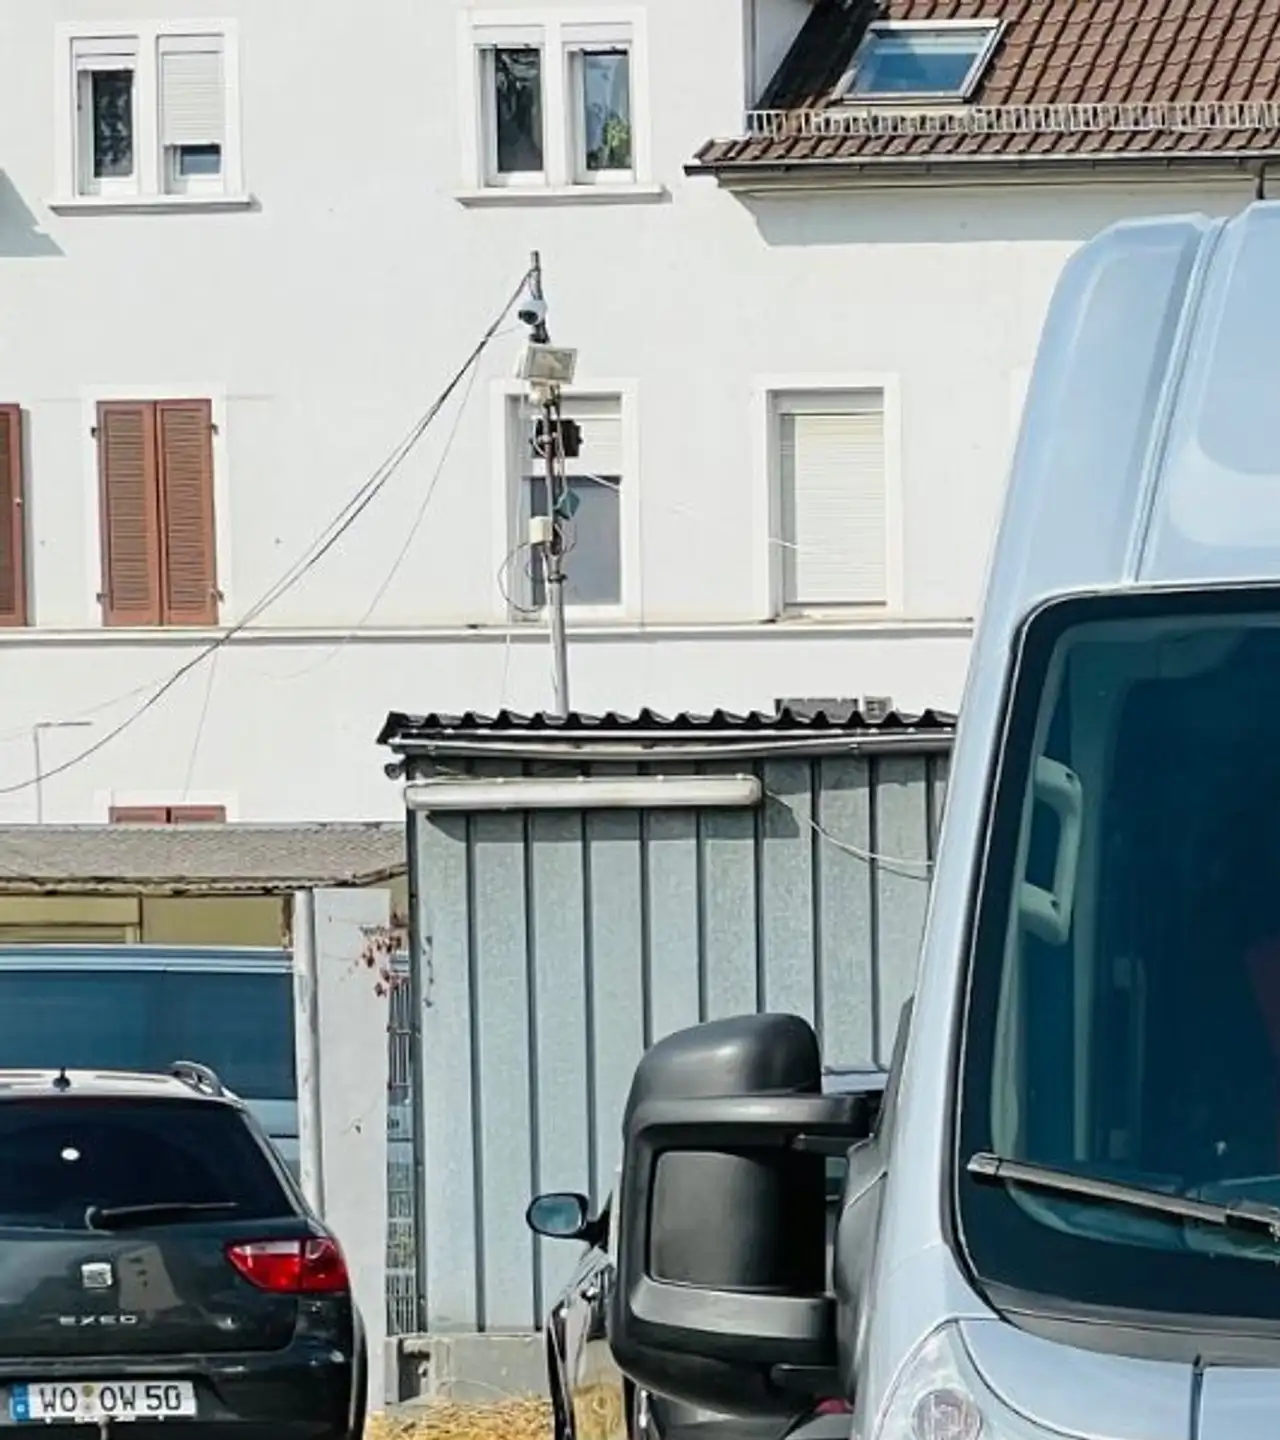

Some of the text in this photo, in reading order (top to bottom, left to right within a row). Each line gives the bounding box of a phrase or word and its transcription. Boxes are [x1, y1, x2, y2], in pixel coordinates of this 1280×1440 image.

[39, 1385, 182, 1413] WO OW 50
